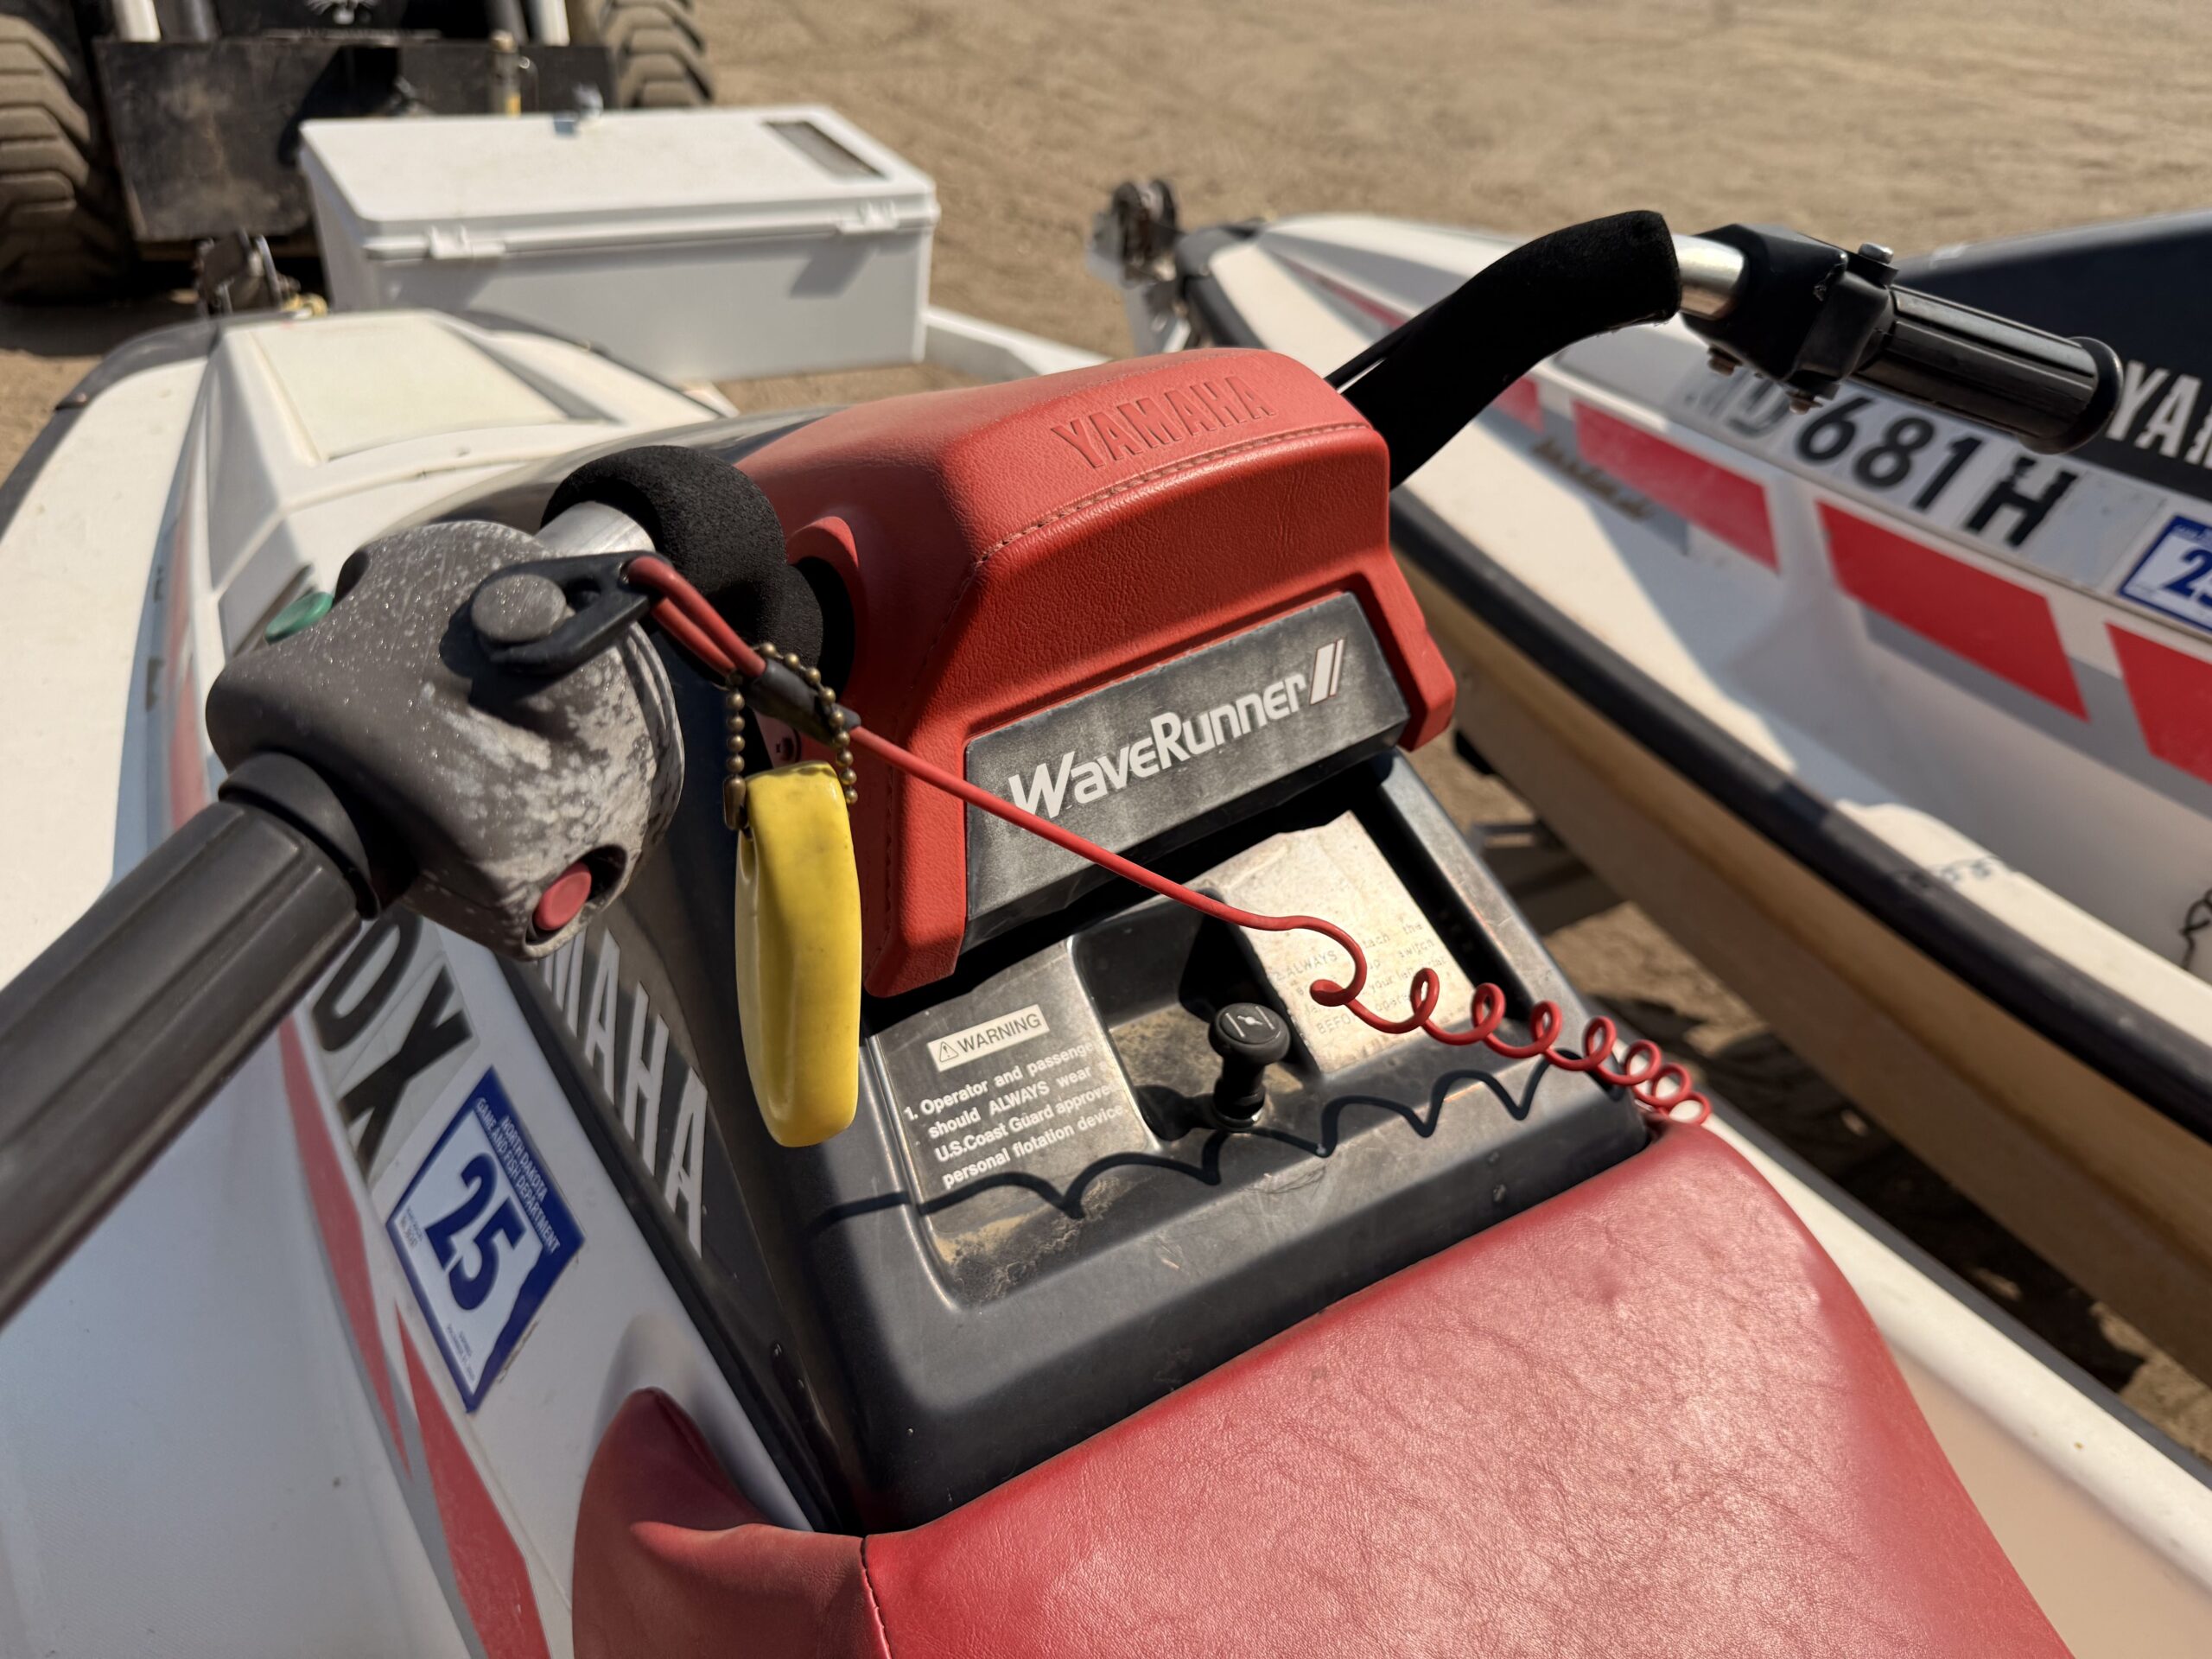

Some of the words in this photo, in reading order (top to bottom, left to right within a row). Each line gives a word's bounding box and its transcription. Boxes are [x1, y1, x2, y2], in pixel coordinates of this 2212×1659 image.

[1051, 375, 1276, 468] YAMAHA
[2107, 359, 2212, 469] YA
[1796, 397, 1983, 512] 681
[1963, 455, 2078, 548] H
[2162, 548, 2212, 610] 2
[1007, 672, 1307, 819] WaveRunner
[957, 1012, 1042, 1053] WARNING
[1316, 1013, 1353, 1034] BEFO
[533, 925, 708, 1259] MAHA
[920, 1079, 988, 1117] Operator
[994, 1066, 1023, 1089] and
[928, 1108, 982, 1139] should
[988, 1079, 1050, 1116] ALWAYS
[1055, 1065, 1092, 1088] wear
[1008, 1103, 1054, 1134] Guard
[476, 1096, 498, 1132] GAME
[491, 1126, 509, 1154] AND
[504, 1150, 522, 1180] FISH
[516, 1174, 561, 1254] DEPARTMENT
[501, 1115, 525, 1155] NORTH
[520, 1153, 549, 1203] DAKOTA
[941, 1147, 1011, 1190] personal
[1012, 1123, 1075, 1159] flotation
[424, 1150, 526, 1311] 25
